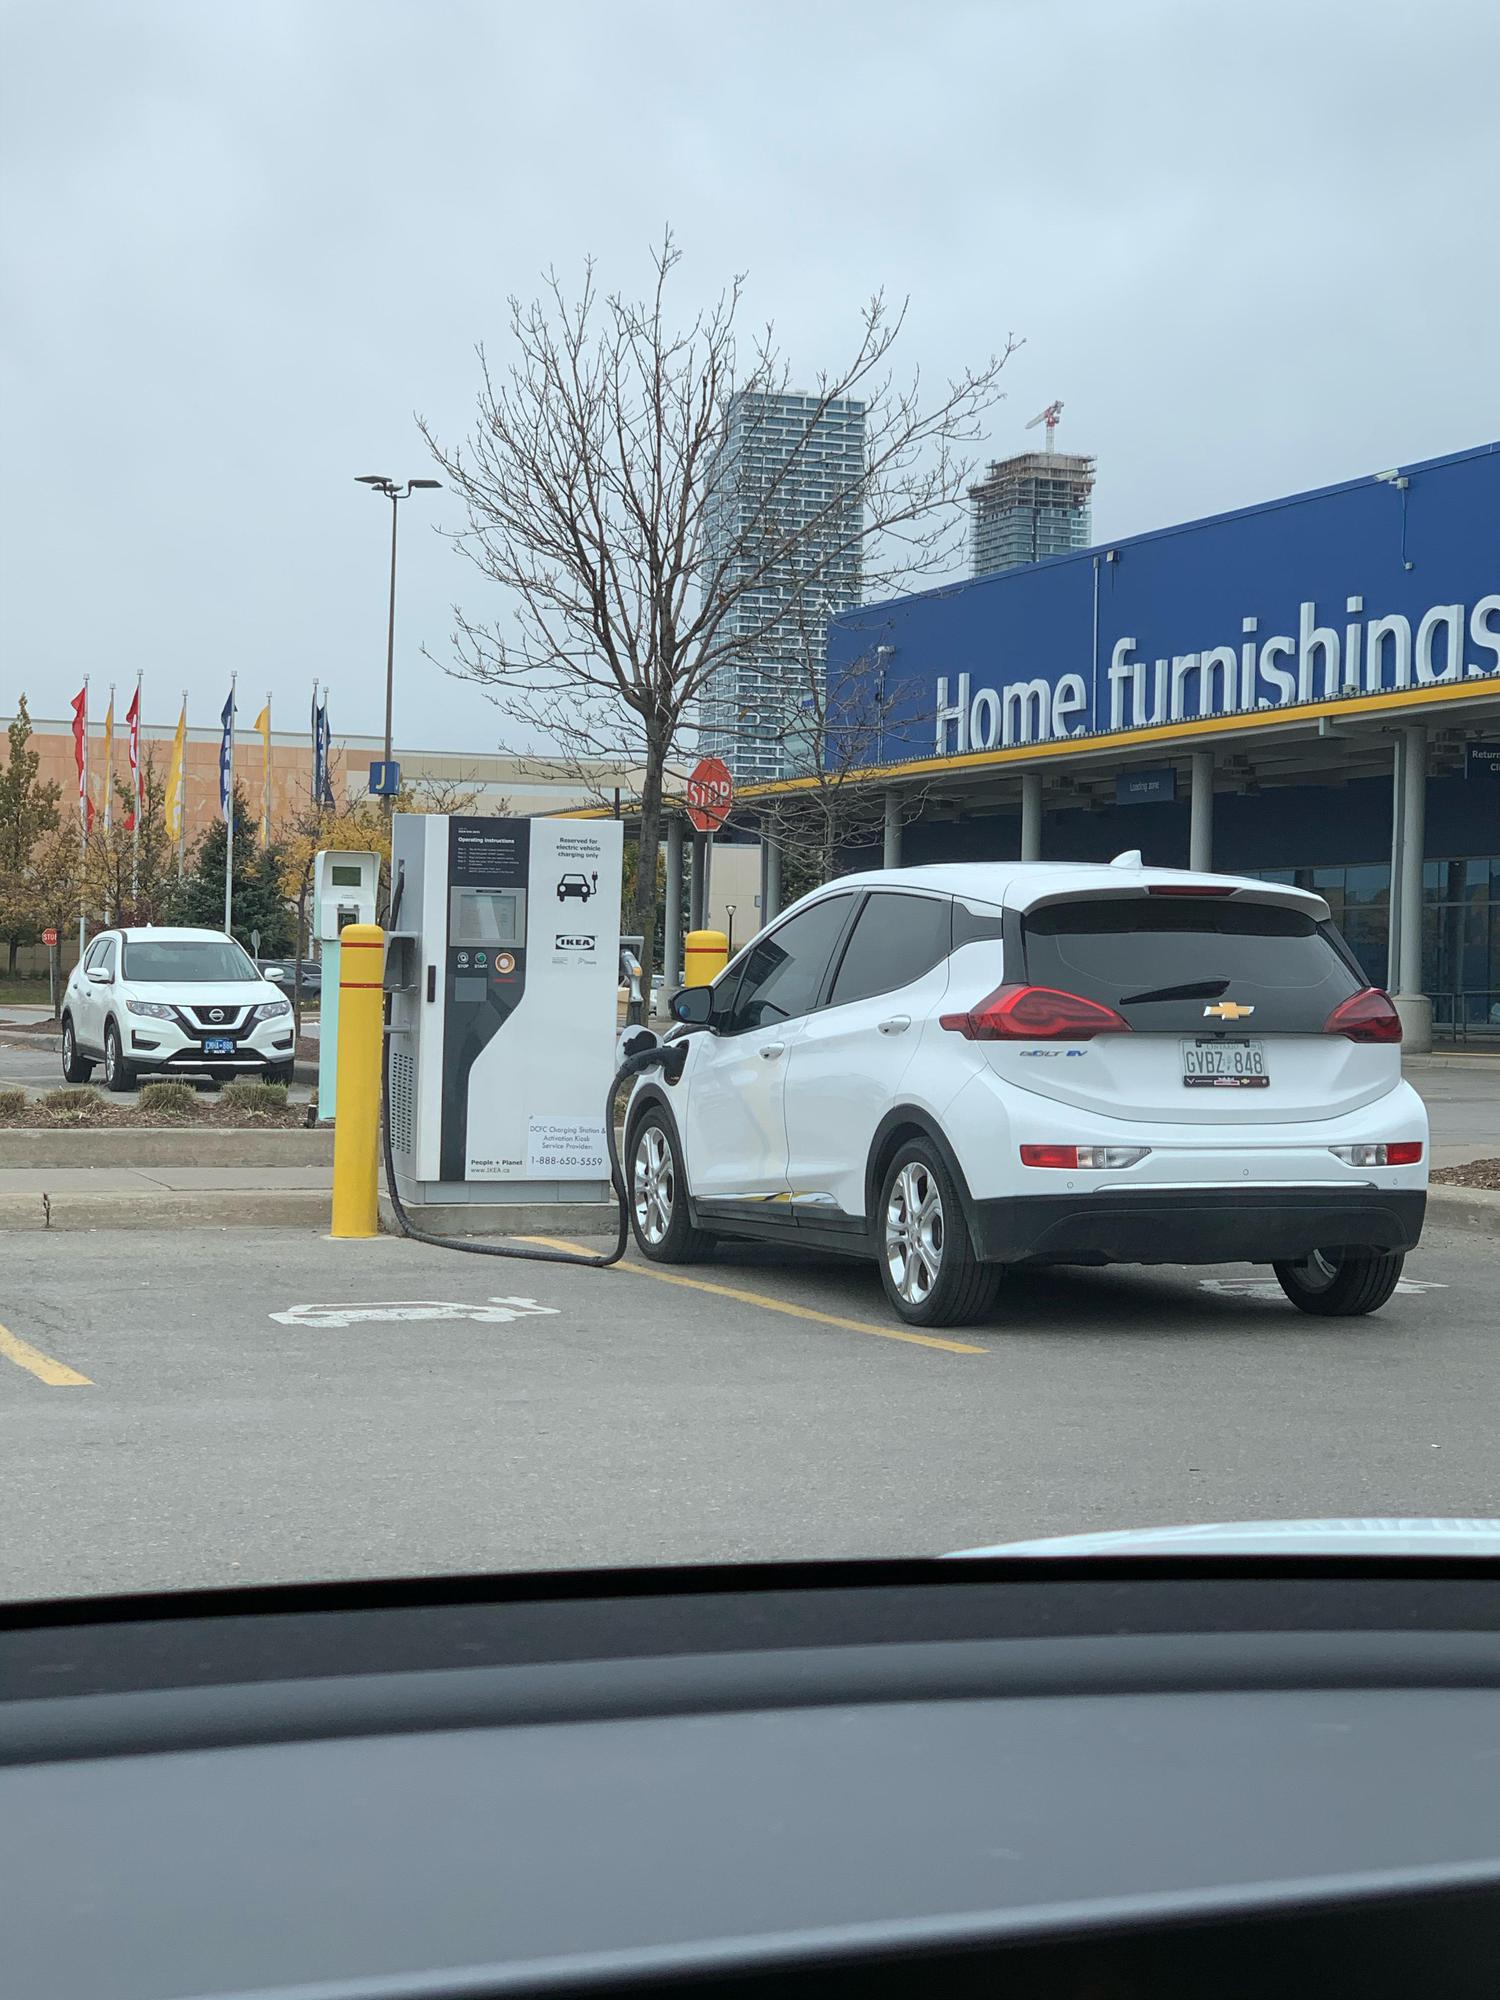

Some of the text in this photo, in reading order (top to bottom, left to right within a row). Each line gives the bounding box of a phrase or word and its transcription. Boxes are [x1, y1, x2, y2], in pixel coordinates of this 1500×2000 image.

[936, 672, 1087, 754] Home
[375, 765, 386, 790] J
[690, 781, 730, 807] STOP
[458, 836, 484, 844] Operating
[557, 851, 585, 859] charging
[560, 938, 591, 946] IKEA
[1234, 1051, 1263, 1075] 848
[529, 1125, 548, 1133] DCFC
[549, 1126, 578, 1134] Charging
[578, 1126, 600, 1134] Station
[531, 1156, 603, 1166] 1-888-650-5559
